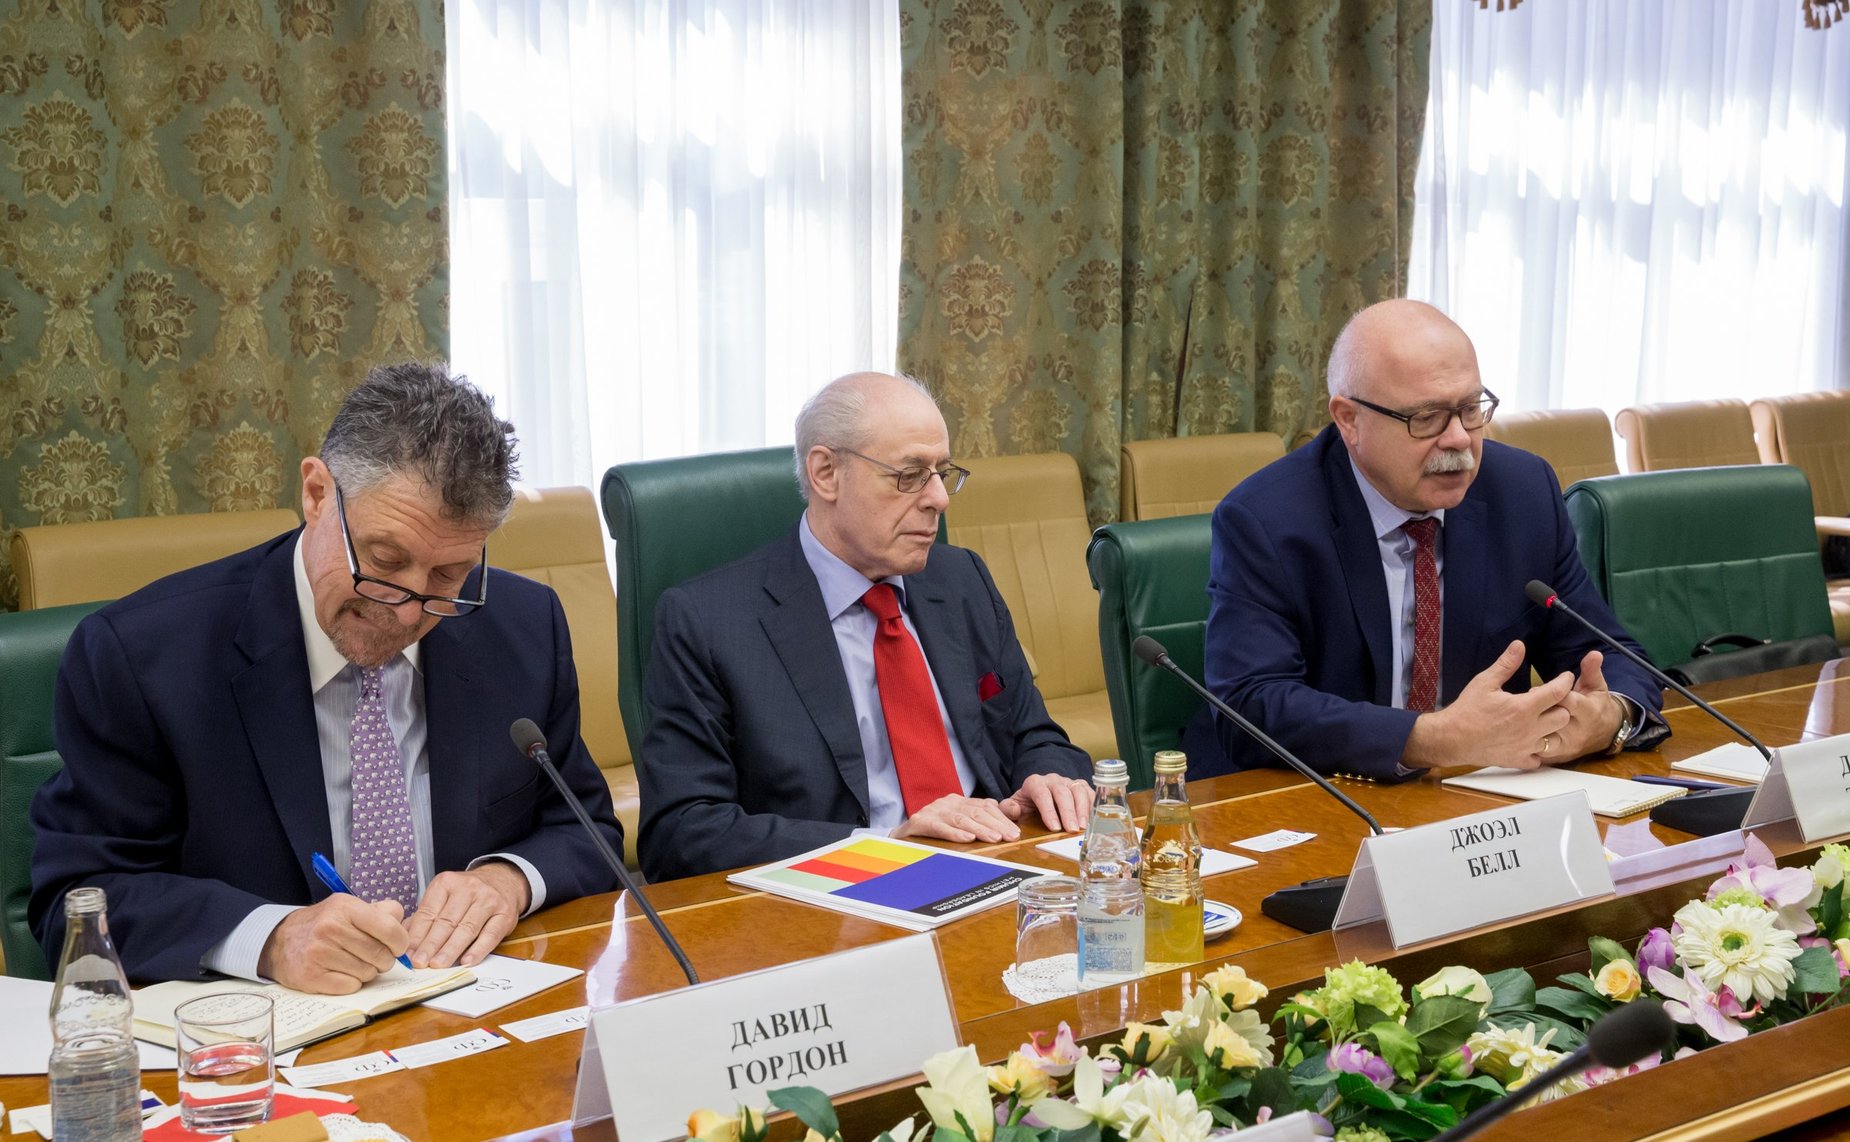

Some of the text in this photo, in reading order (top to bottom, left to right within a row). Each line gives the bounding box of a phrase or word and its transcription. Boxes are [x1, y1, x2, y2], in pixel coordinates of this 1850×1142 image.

[1449, 816, 1522, 854] ДЖОЭЛ
[1467, 849, 1521, 878] БЕЛЛ
[731, 1003, 833, 1053] ДАВИД
[727, 1040, 849, 1090] ГОРДОН
